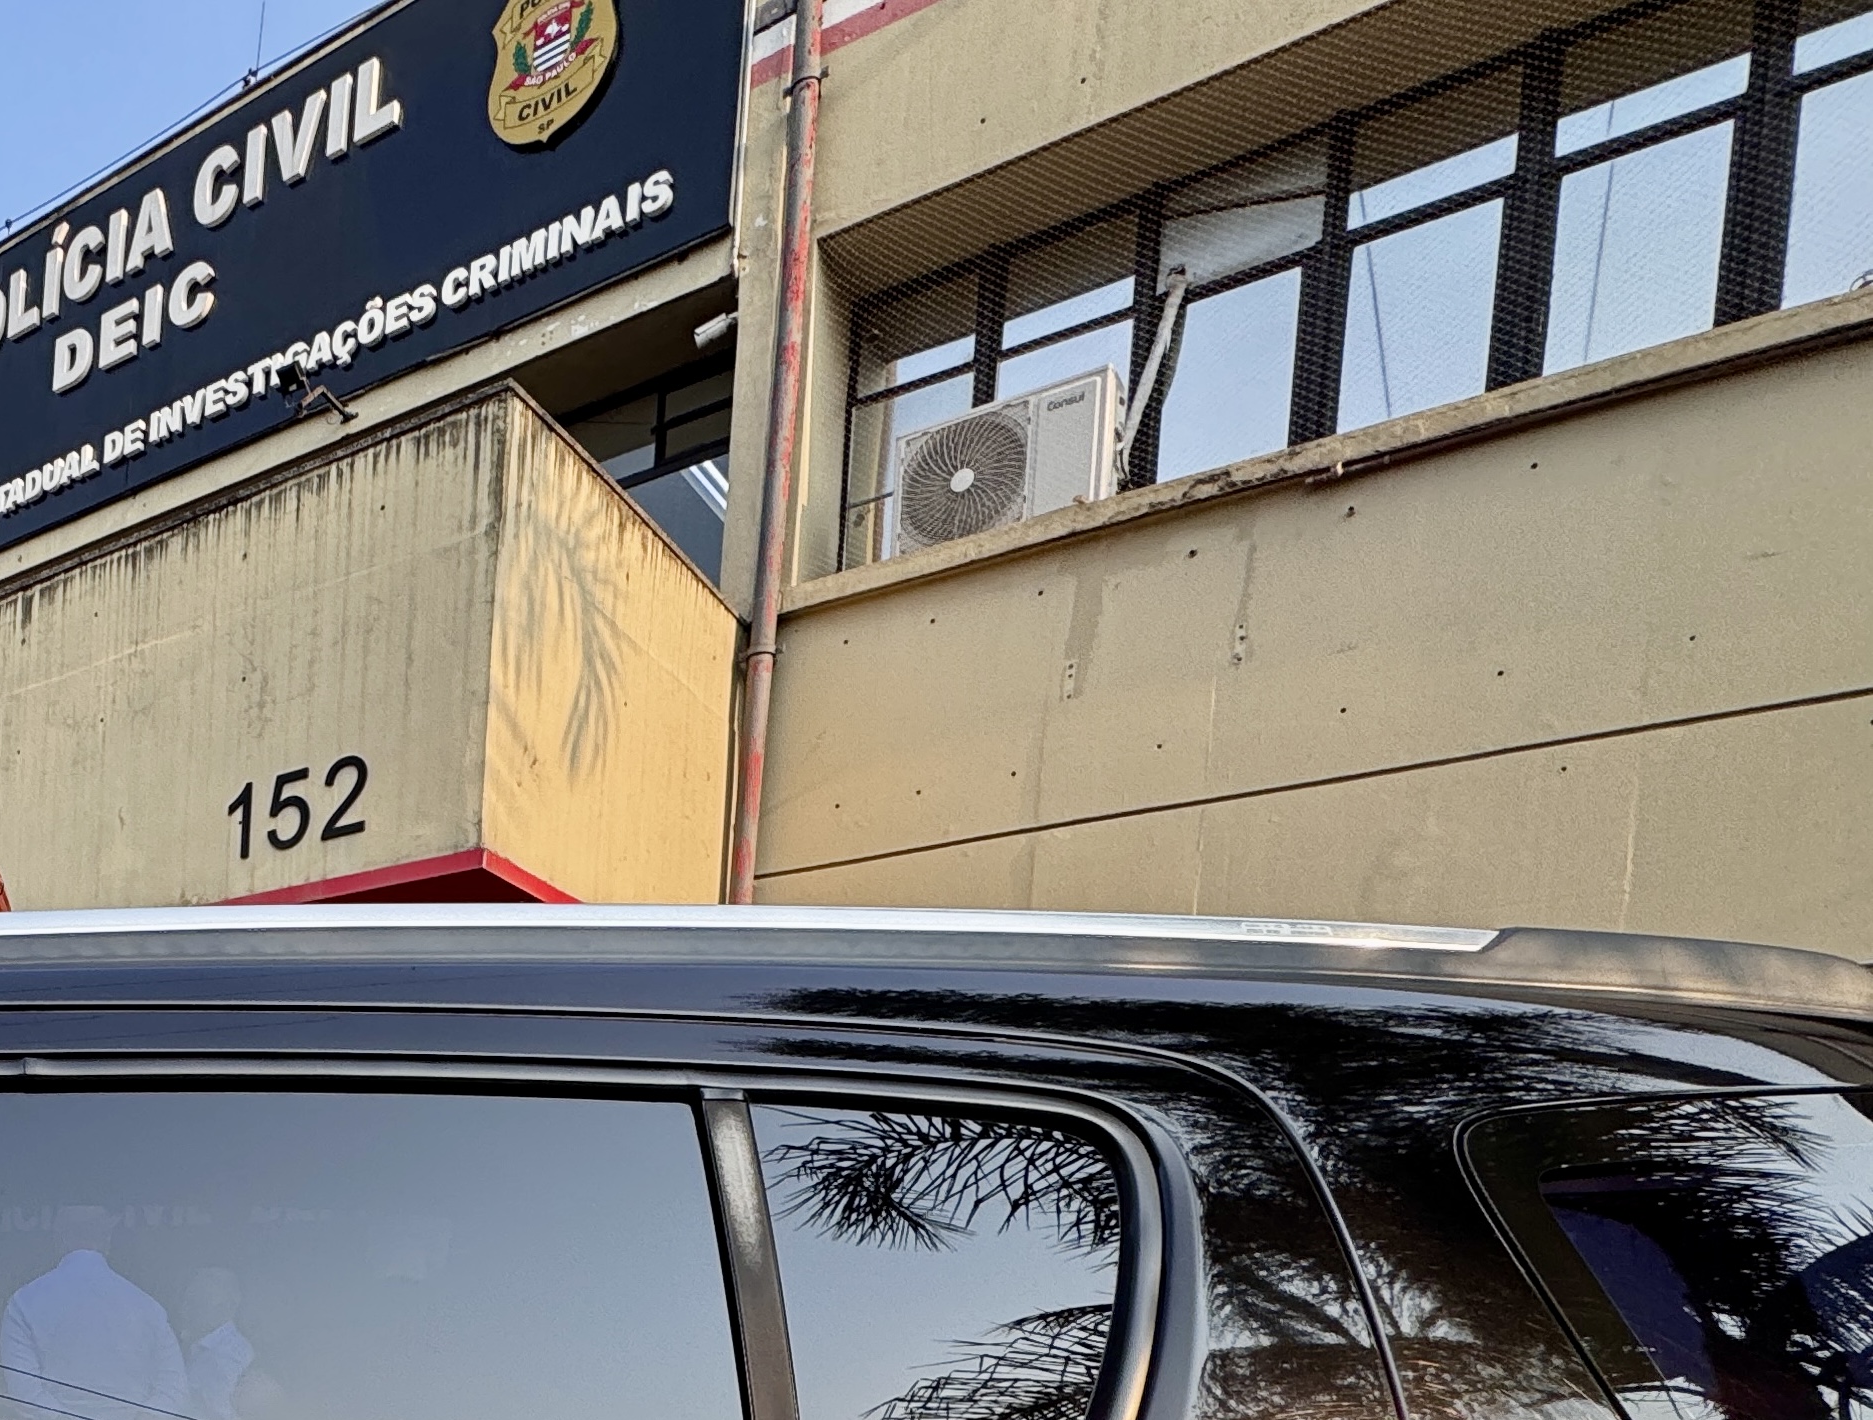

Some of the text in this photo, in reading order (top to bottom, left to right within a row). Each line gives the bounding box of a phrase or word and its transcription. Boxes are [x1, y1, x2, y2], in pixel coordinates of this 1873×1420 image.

[193, 56, 403, 228] CIVIL
[517, 81, 578, 121] CIVIL
[537, 118, 554, 134] SP
[52, 261, 216, 394] DEIC
[103, 419, 147, 465] DE
[148, 283, 437, 445] INVESTIGAÇÕES
[441, 169, 674, 308] CRIMINAIS
[228, 755, 368, 860] 152
